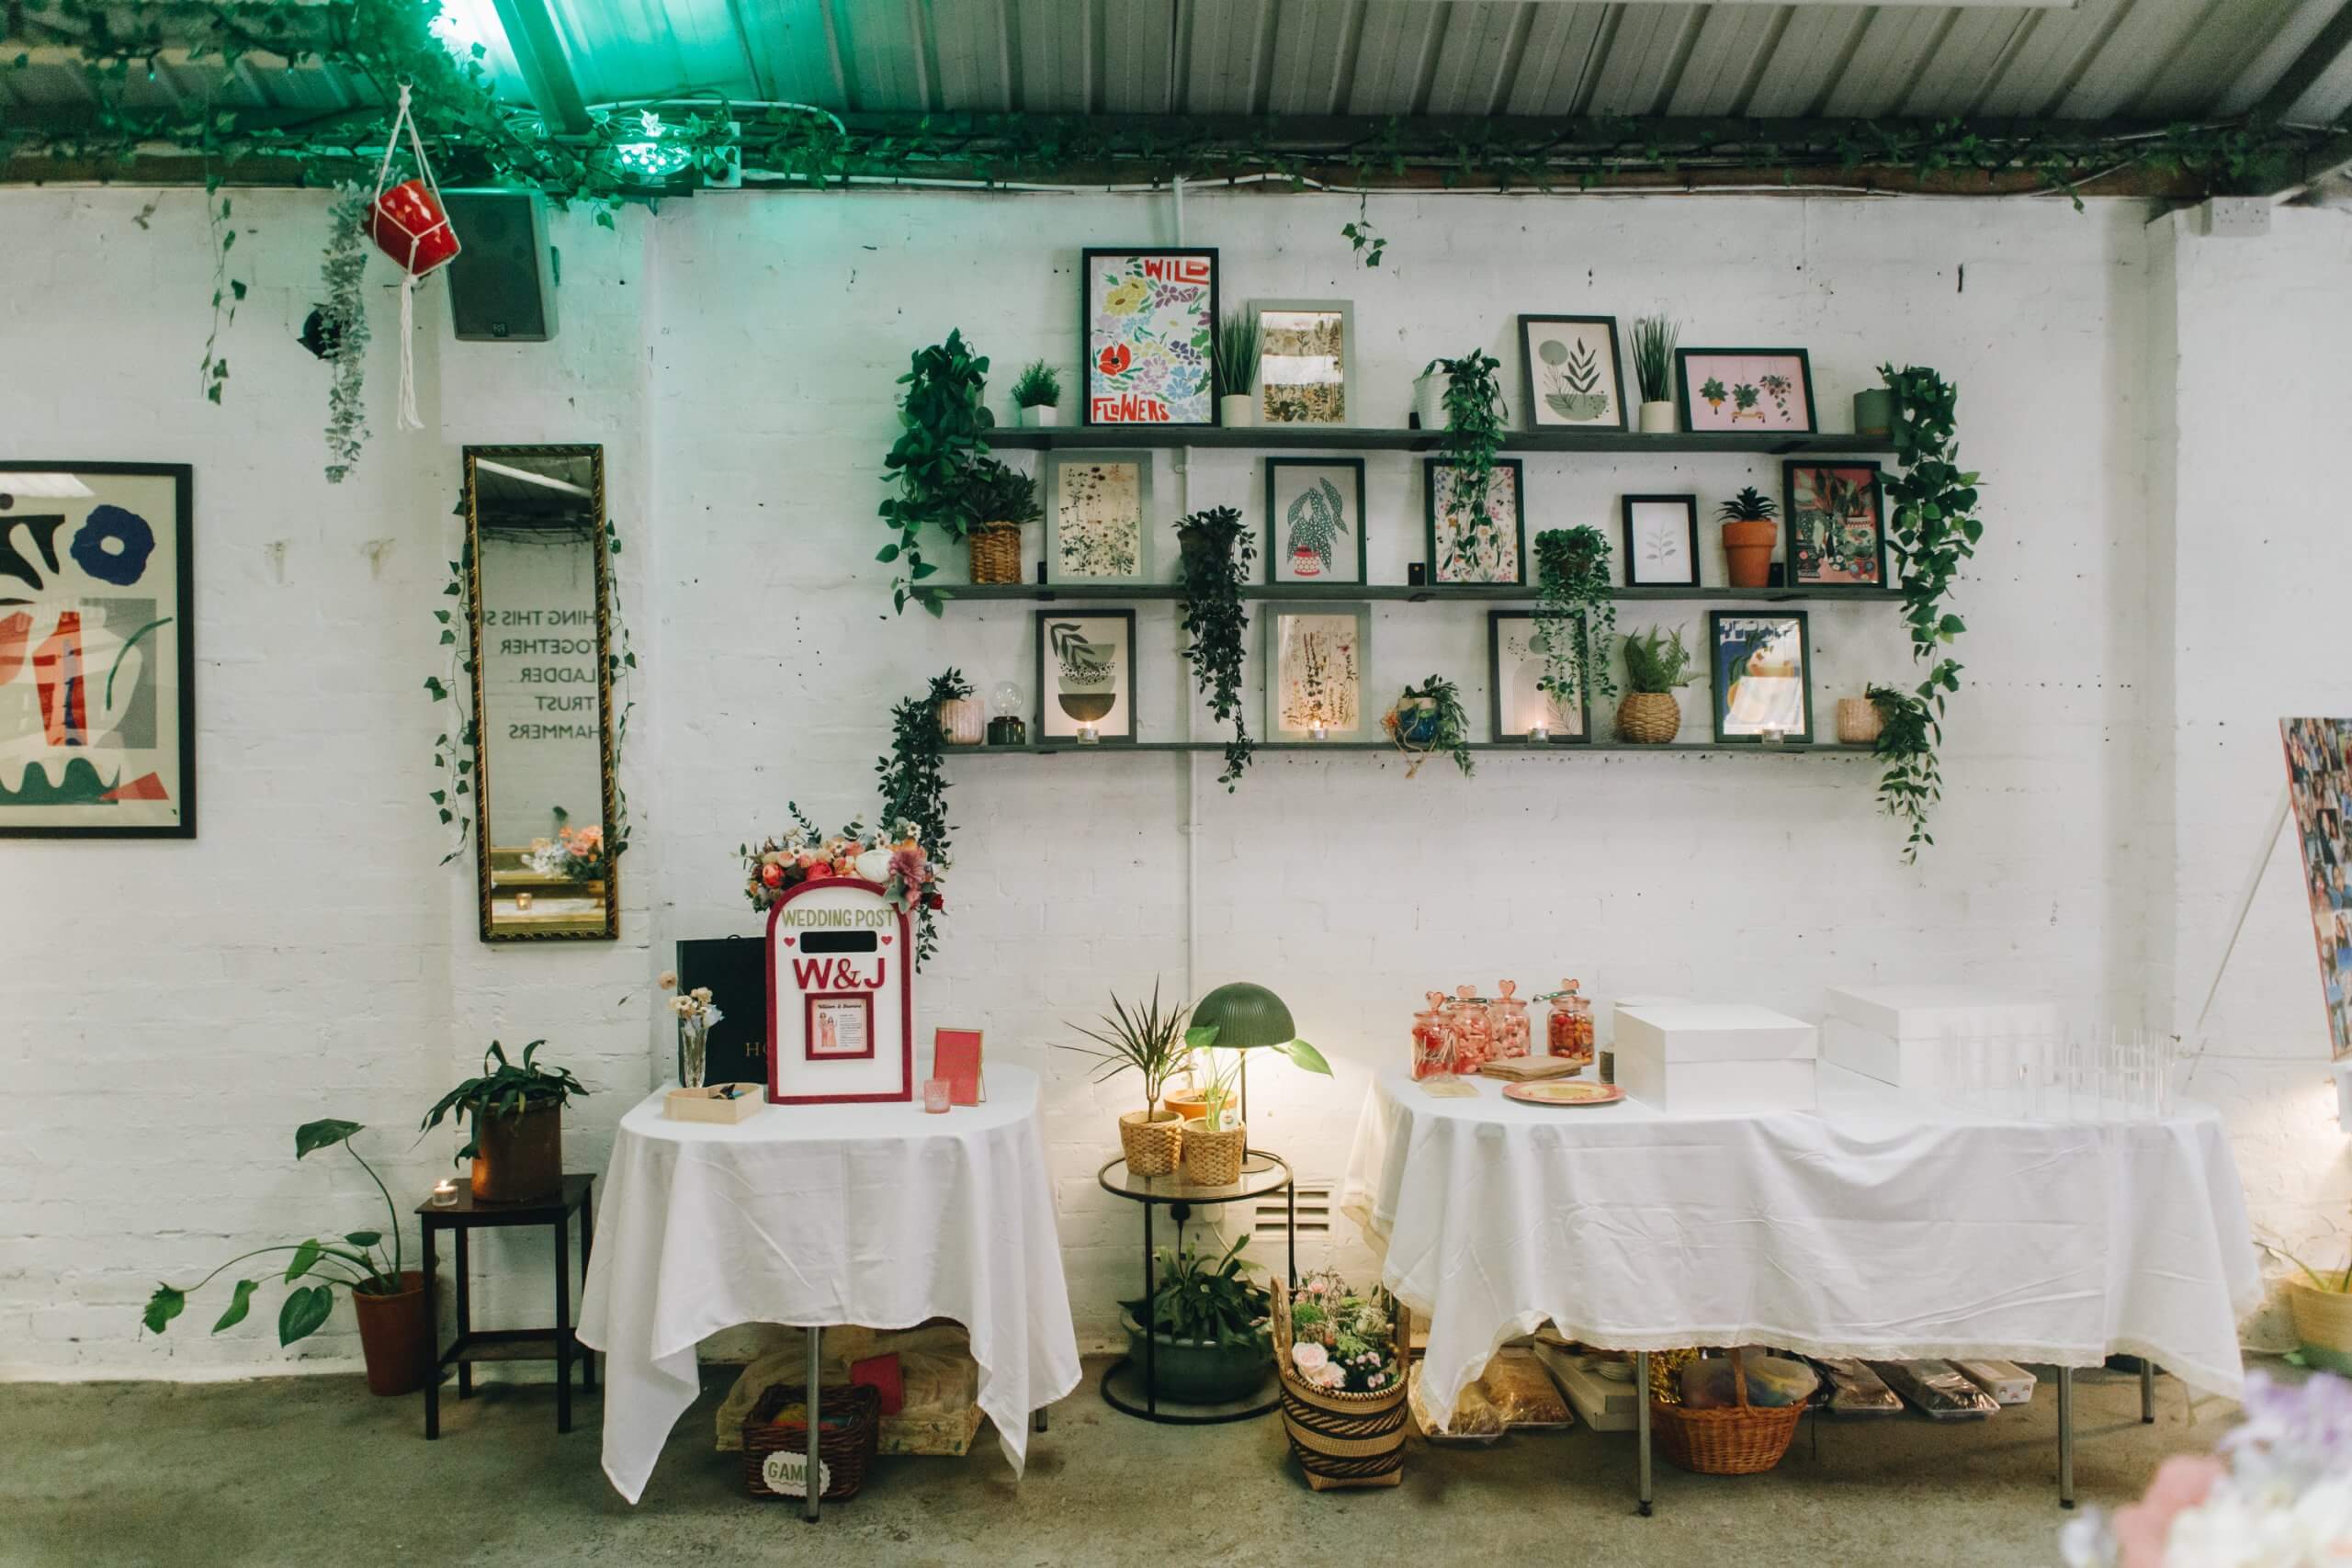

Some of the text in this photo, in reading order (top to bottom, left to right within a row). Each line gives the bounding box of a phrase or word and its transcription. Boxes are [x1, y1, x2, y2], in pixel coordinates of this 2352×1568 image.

[1144, 259, 1210, 286] WILD
[1092, 393, 1170, 423] FLOWERS
[782, 908, 897, 927] WEDDING POST
[792, 957, 886, 990] W&J
[768, 1461, 824, 1482] GAM
